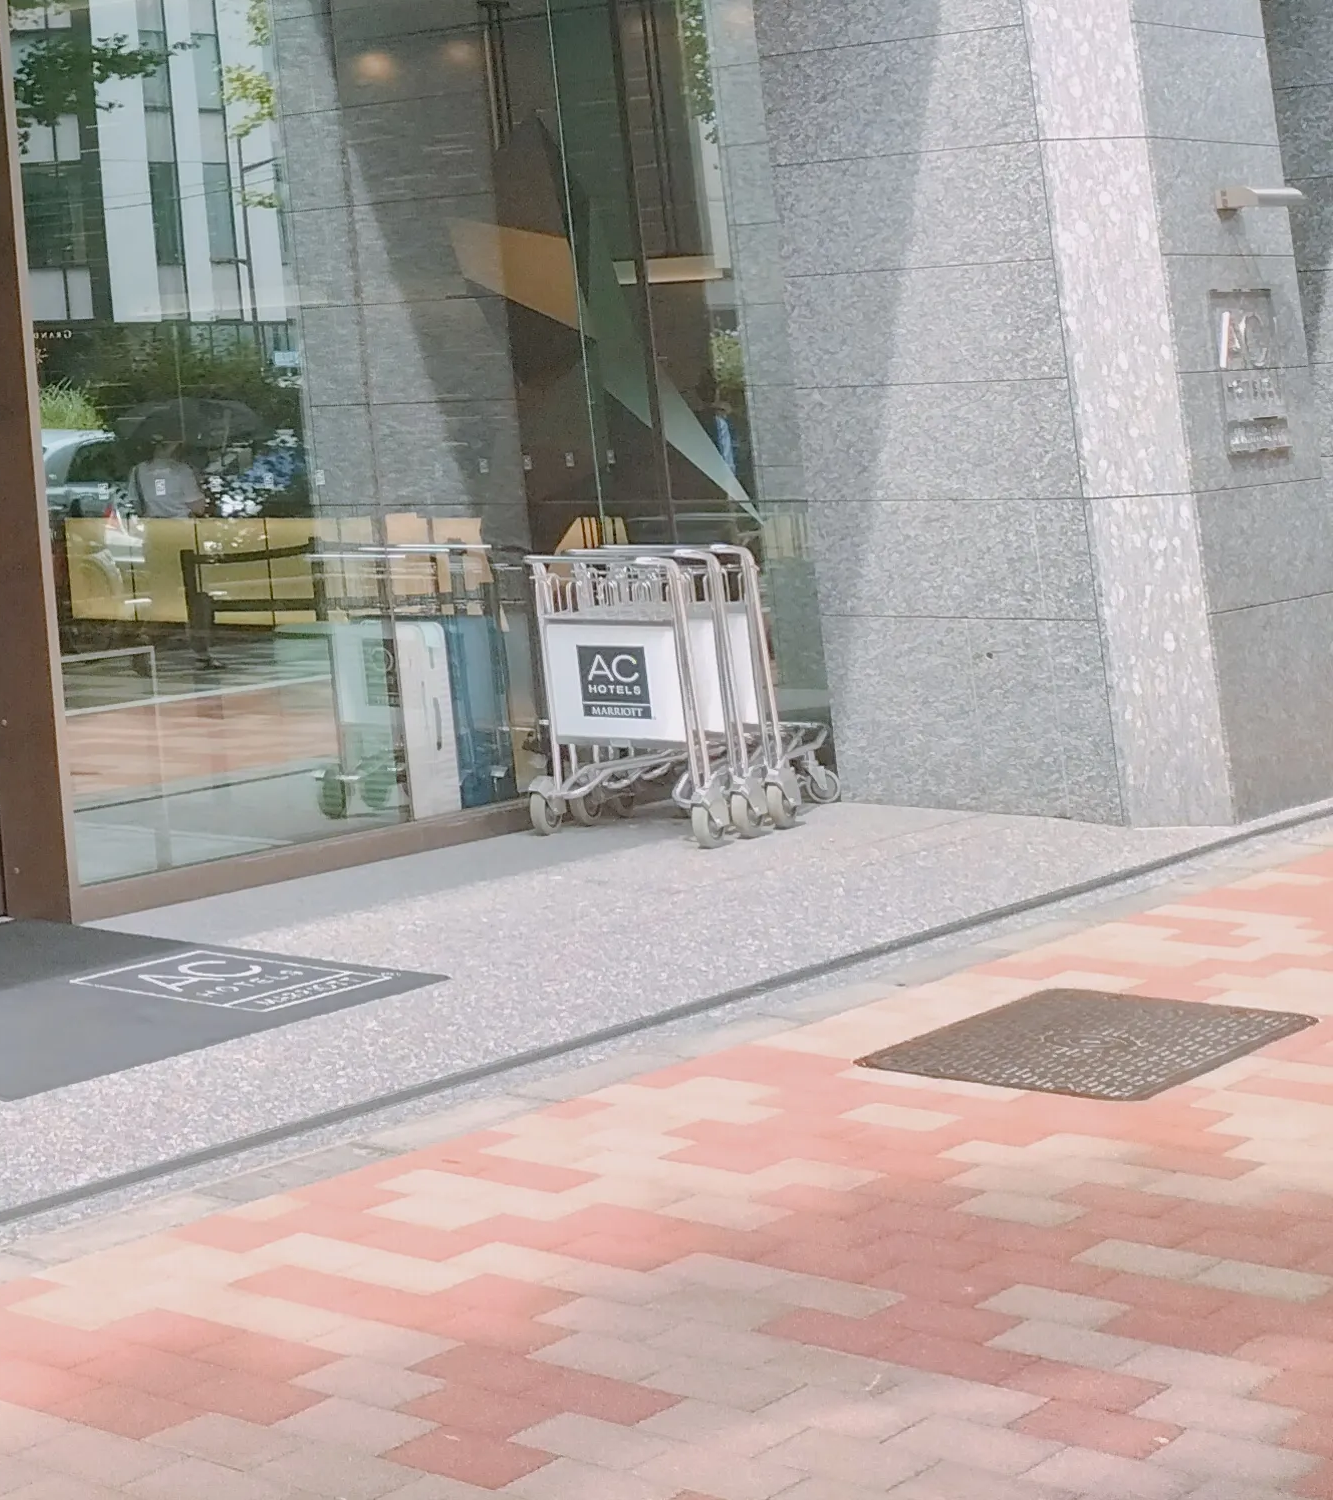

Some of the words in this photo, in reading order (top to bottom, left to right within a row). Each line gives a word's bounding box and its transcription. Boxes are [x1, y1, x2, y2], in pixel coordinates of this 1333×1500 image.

[588, 654, 639, 682] AC
[588, 684, 641, 696] HOTELS
[591, 706, 643, 717] MARRIOTT
[138, 960, 262, 993] AC
